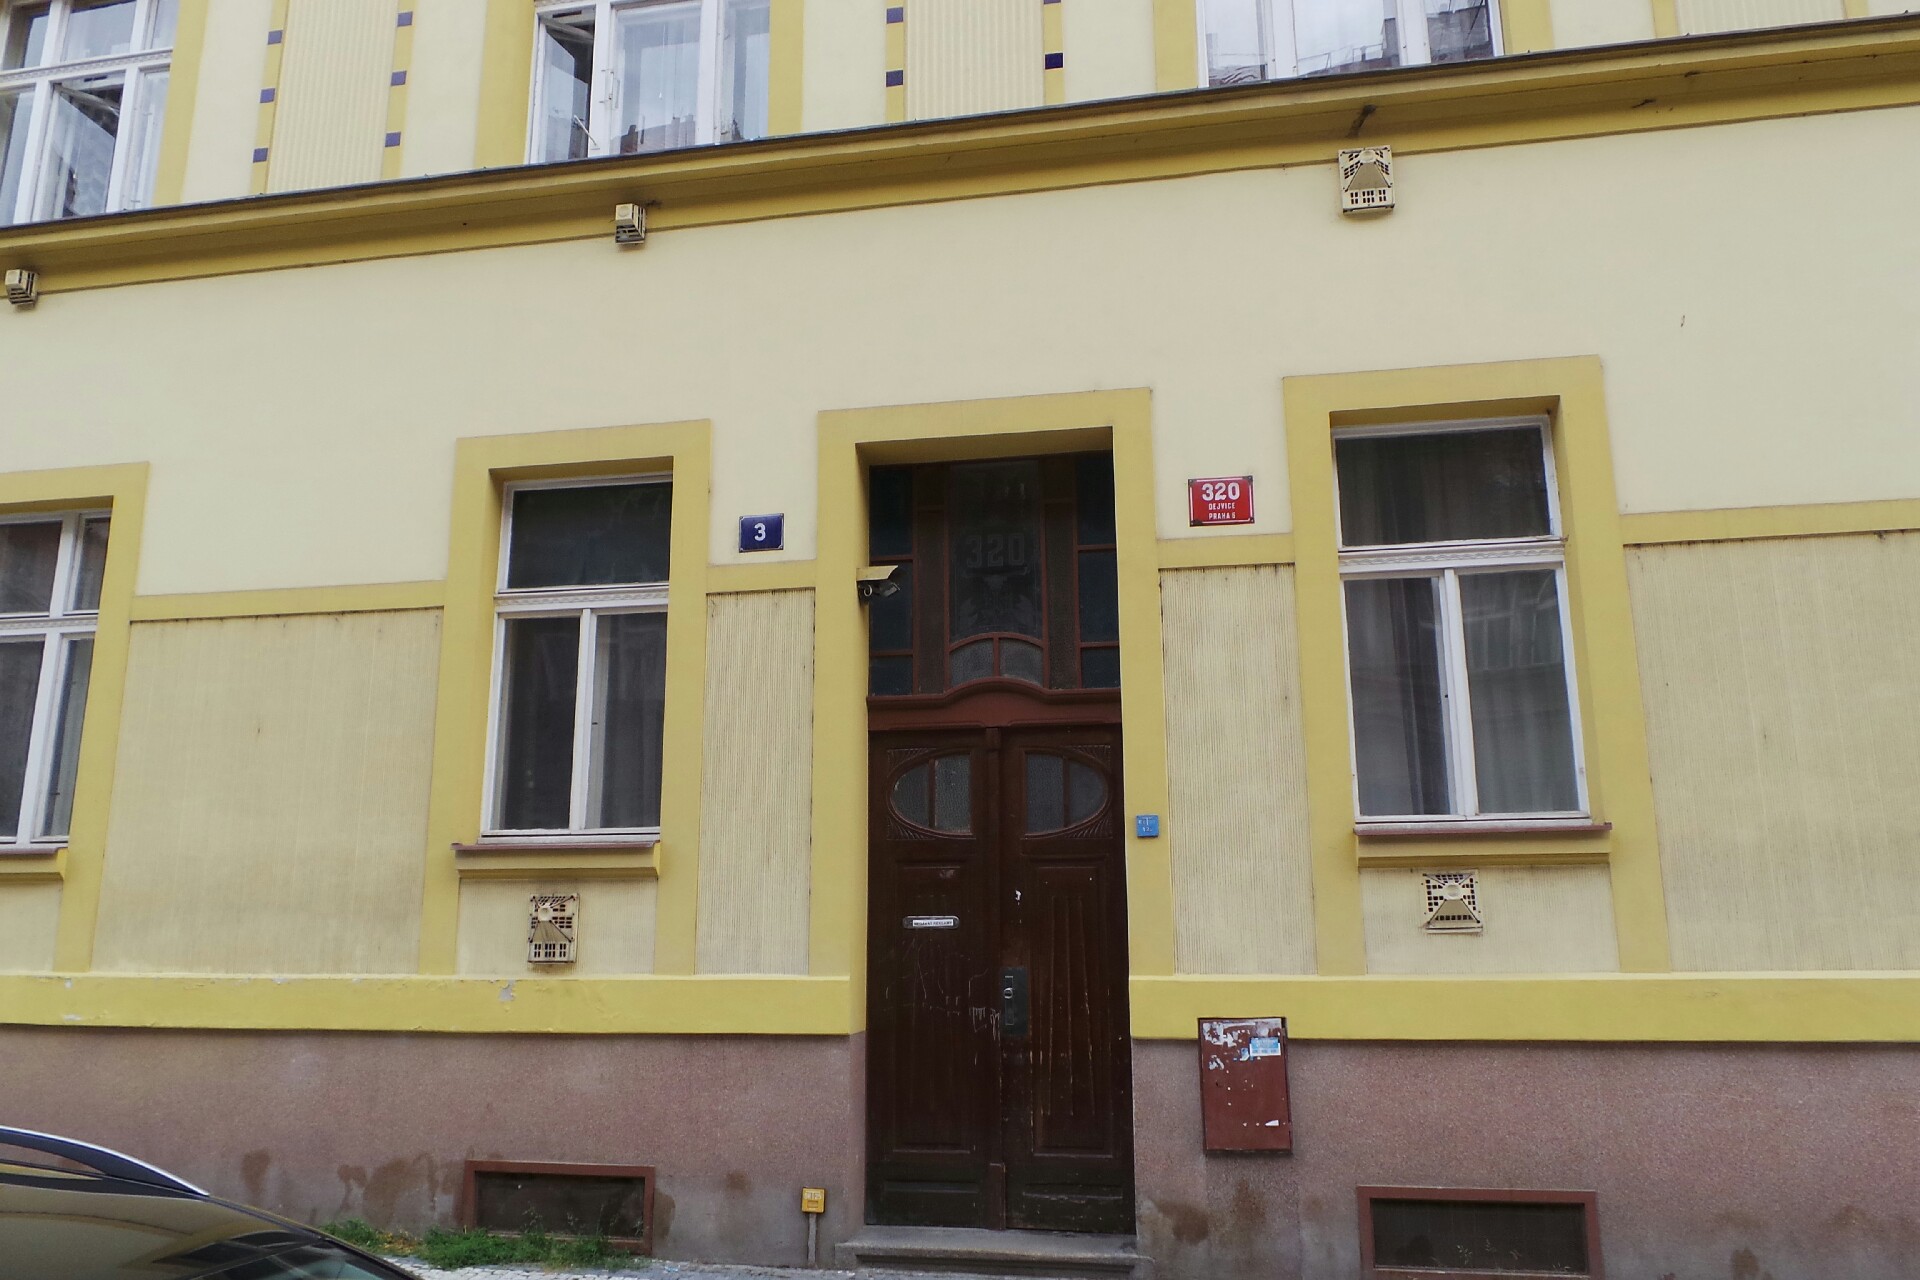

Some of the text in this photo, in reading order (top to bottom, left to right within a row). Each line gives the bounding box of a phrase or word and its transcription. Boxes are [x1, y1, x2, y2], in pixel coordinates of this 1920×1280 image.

[1201, 482, 1240, 501] 320
[1208, 502, 1236, 511] DEJVICE
[1208, 512, 1231, 520] PRAHA
[754, 522, 766, 542] 3
[966, 533, 1025, 568] 320
